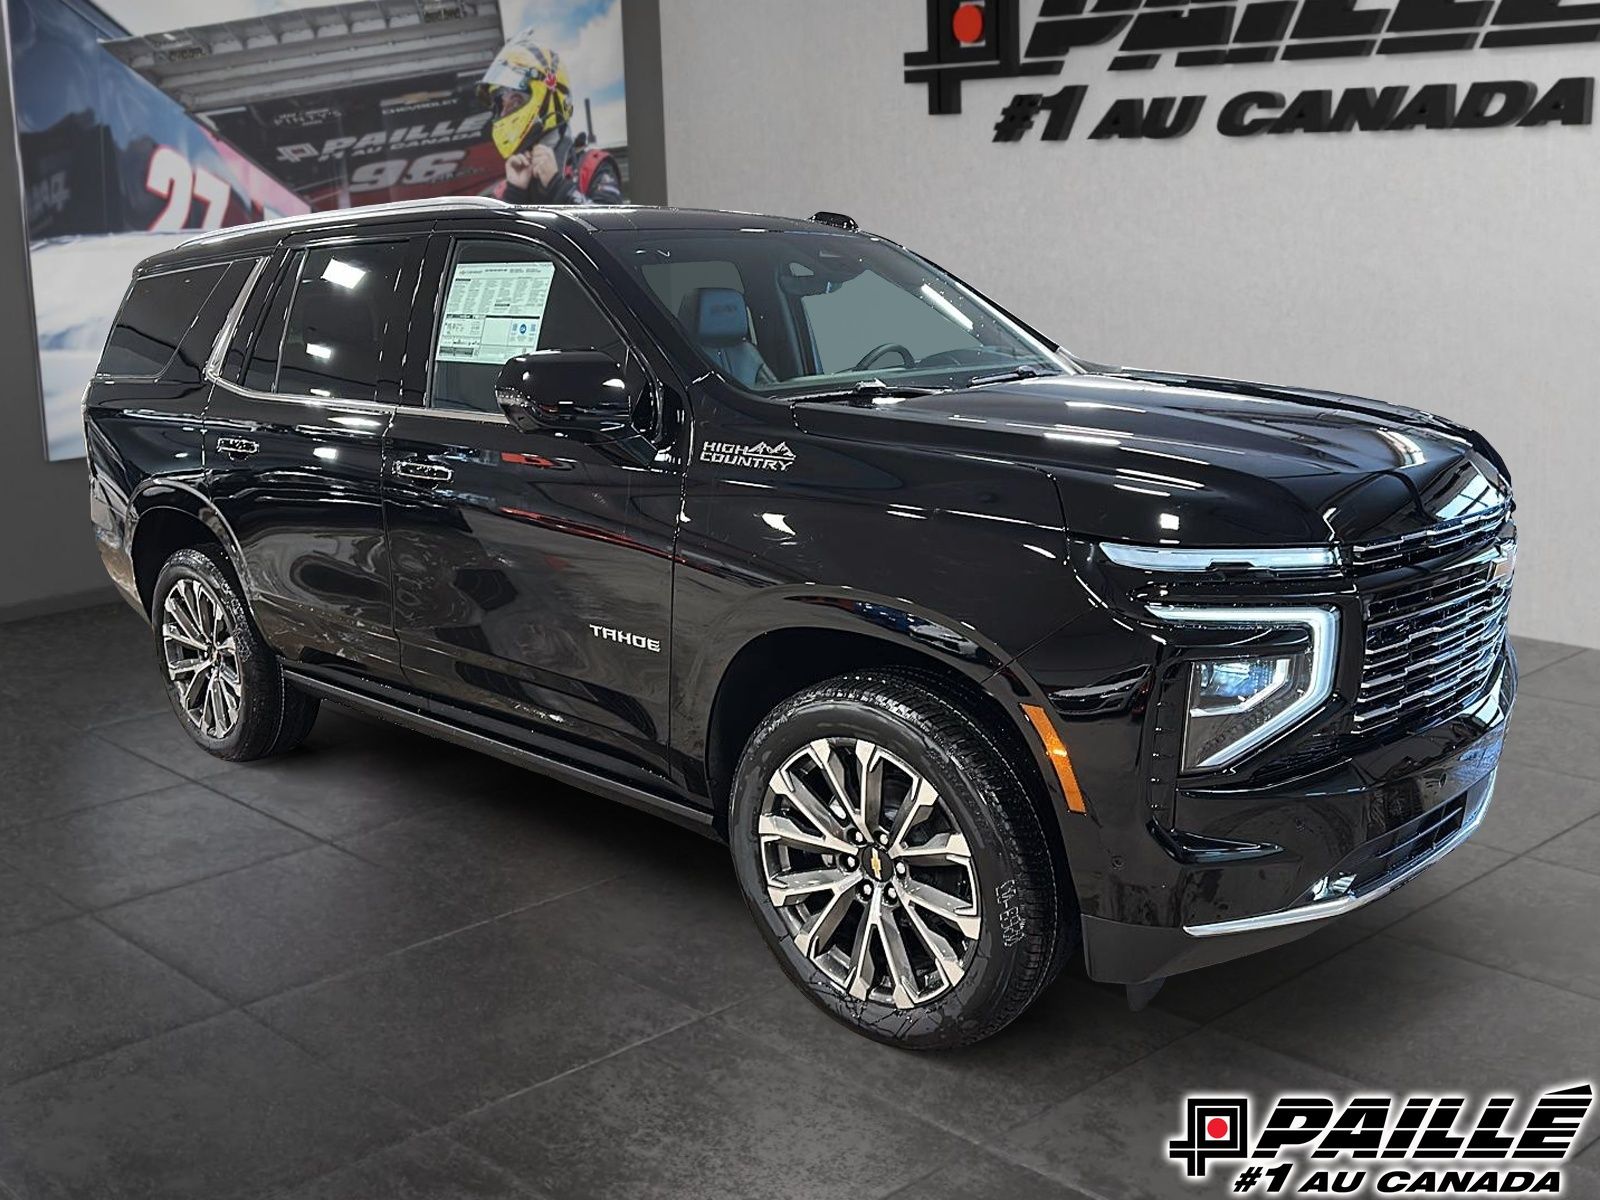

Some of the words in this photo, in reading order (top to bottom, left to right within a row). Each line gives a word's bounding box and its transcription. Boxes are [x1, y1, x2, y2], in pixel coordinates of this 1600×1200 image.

[992, 84, 1089, 142] #1
[1087, 95, 1206, 140] AU
[1215, 77, 1595, 137] CANADA
[389, 131, 482, 151] CANADA
[348, 150, 466, 194] 96
[146, 144, 231, 232] 27
[700, 451, 793, 471] COUNTRY
[703, 441, 749, 455] HIGH
[589, 623, 661, 653] TAHOE
